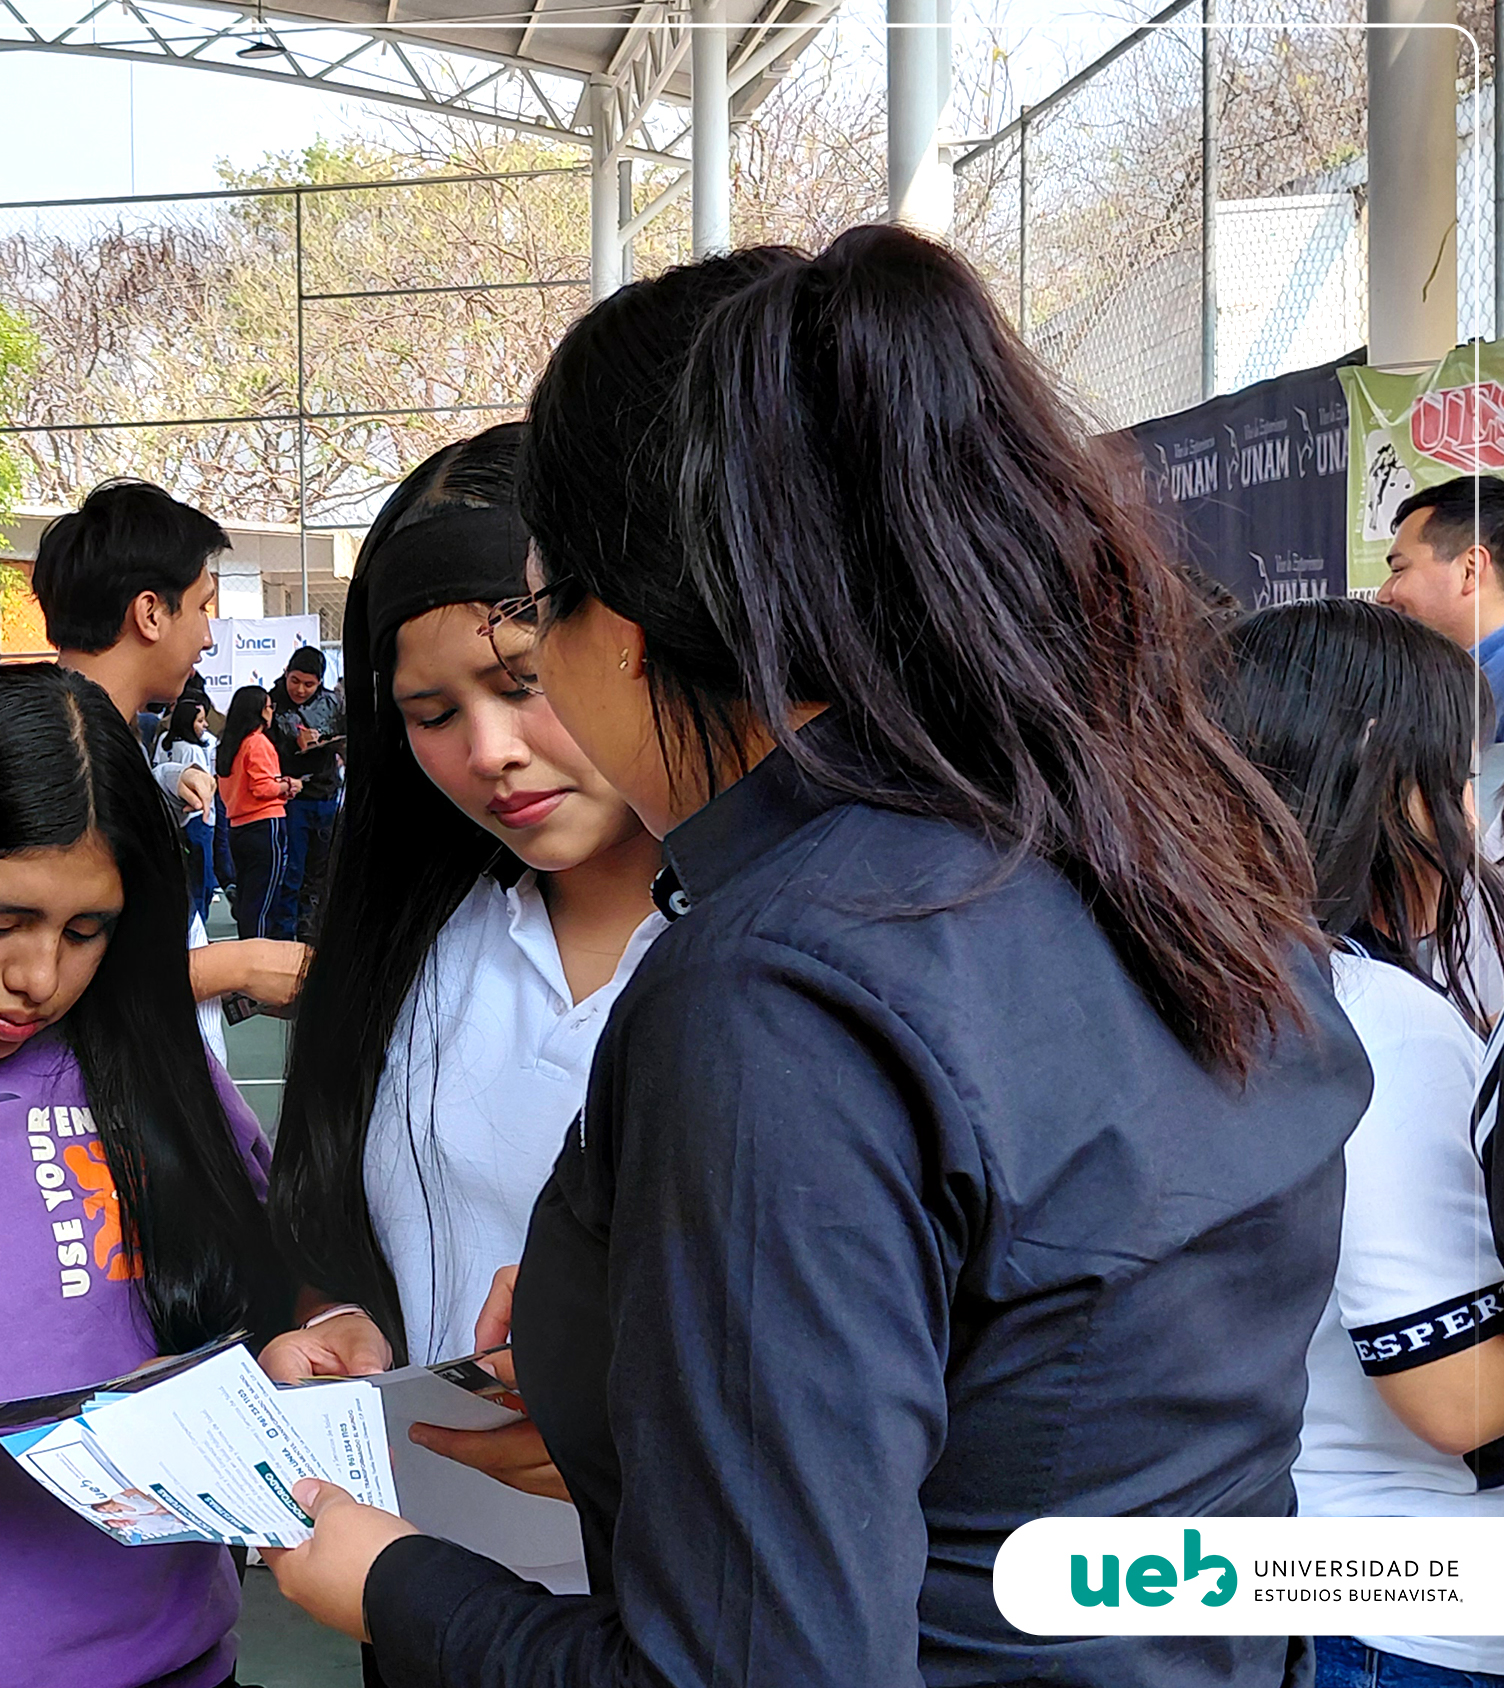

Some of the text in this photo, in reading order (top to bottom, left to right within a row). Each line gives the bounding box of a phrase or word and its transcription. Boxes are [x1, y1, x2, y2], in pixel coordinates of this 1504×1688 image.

[1171, 451, 1219, 502] UNAM
[1241, 435, 1290, 488] UNAM
[53, 1106, 99, 1137] EN
[28, 1105, 91, 1298] USE YOUR
[264, 1471, 307, 1521] DOCTORADO
